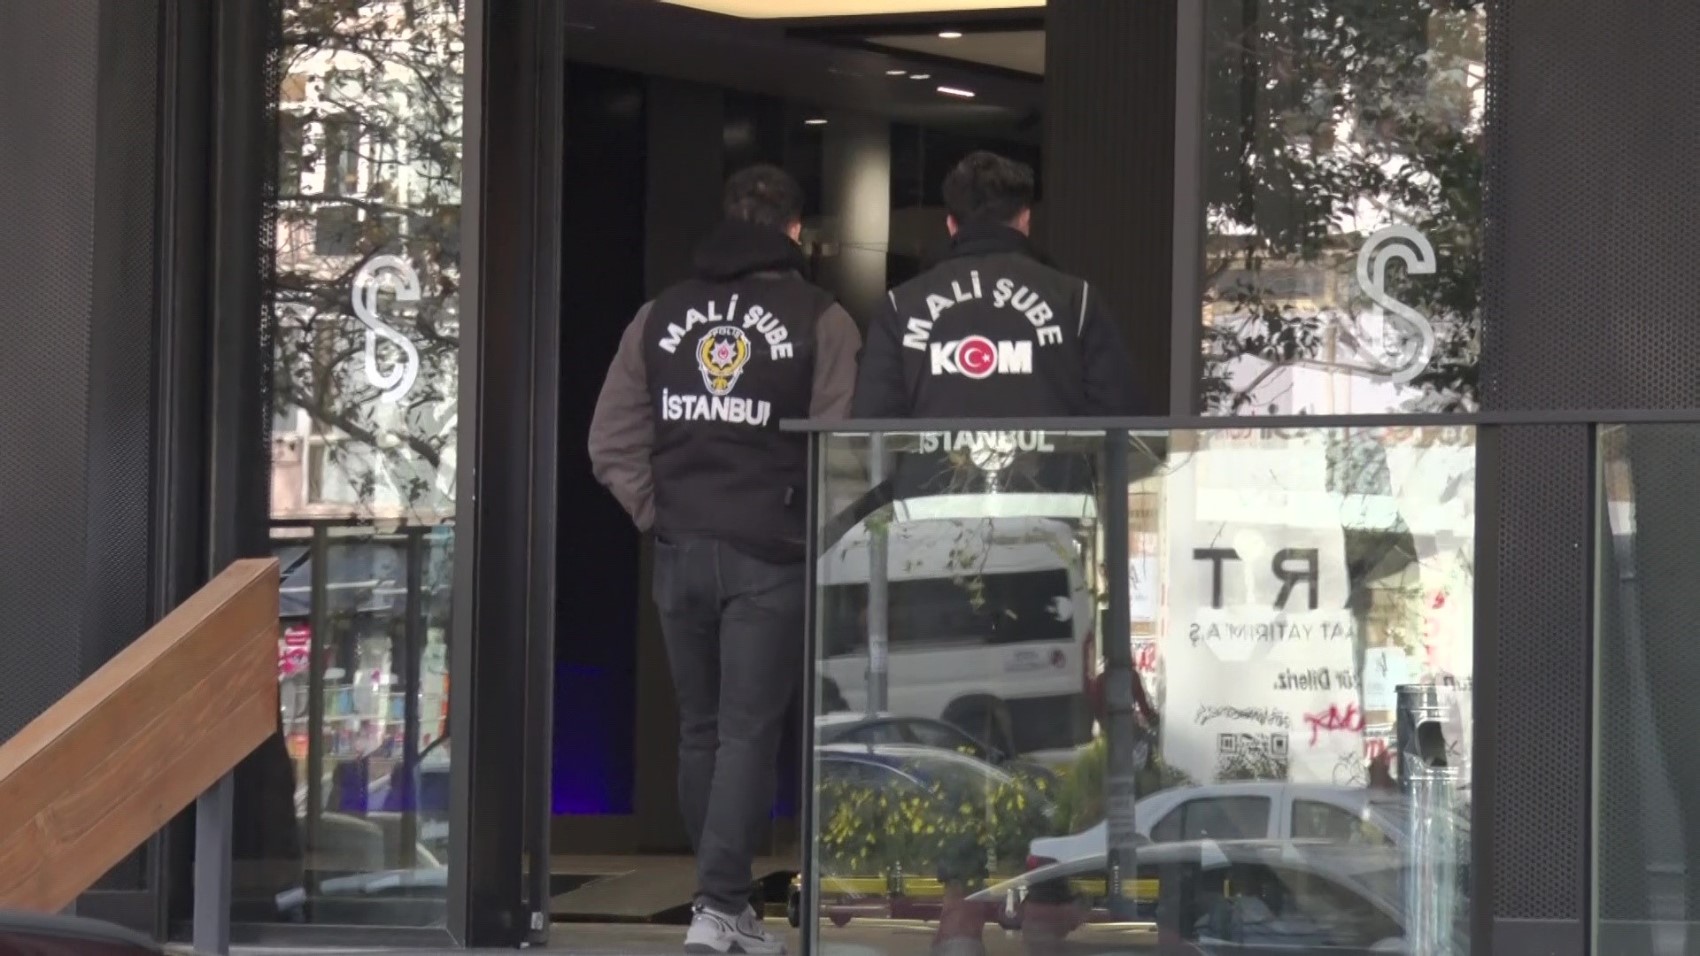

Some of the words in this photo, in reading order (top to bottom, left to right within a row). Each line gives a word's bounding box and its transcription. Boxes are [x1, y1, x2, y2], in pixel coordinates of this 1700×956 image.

[742, 305, 794, 361] ŞUBE
[903, 270, 983, 351] MALİ
[993, 278, 1063, 347] ŞUBE
